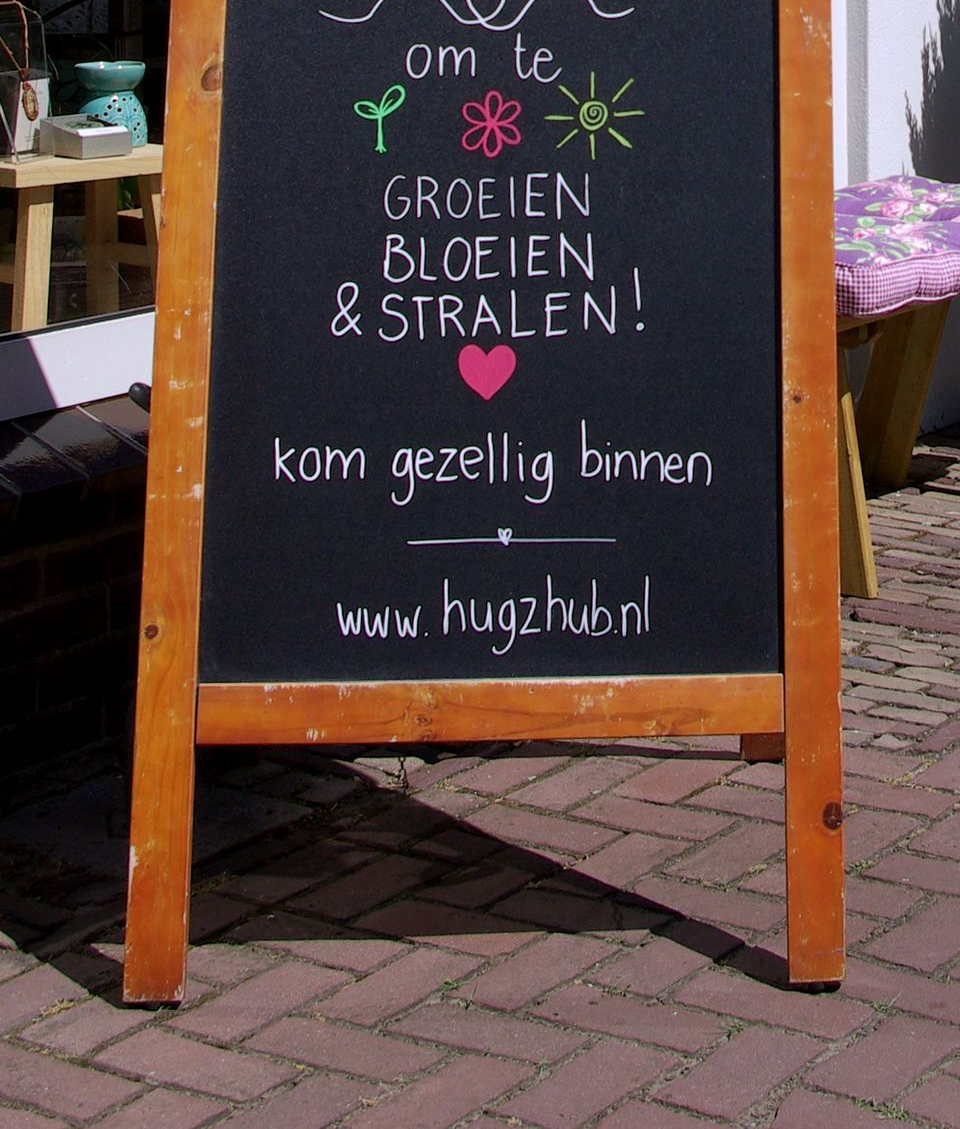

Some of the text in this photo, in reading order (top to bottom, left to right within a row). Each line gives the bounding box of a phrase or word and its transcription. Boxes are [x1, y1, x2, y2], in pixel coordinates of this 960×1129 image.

[406, 33, 562, 82] om te
[384, 172, 590, 219] GROEIEN
[383, 233, 594, 283] BLOEIEN
[331, 281, 362, 337] &
[274, 419, 712, 506] kom gezellig binnen
